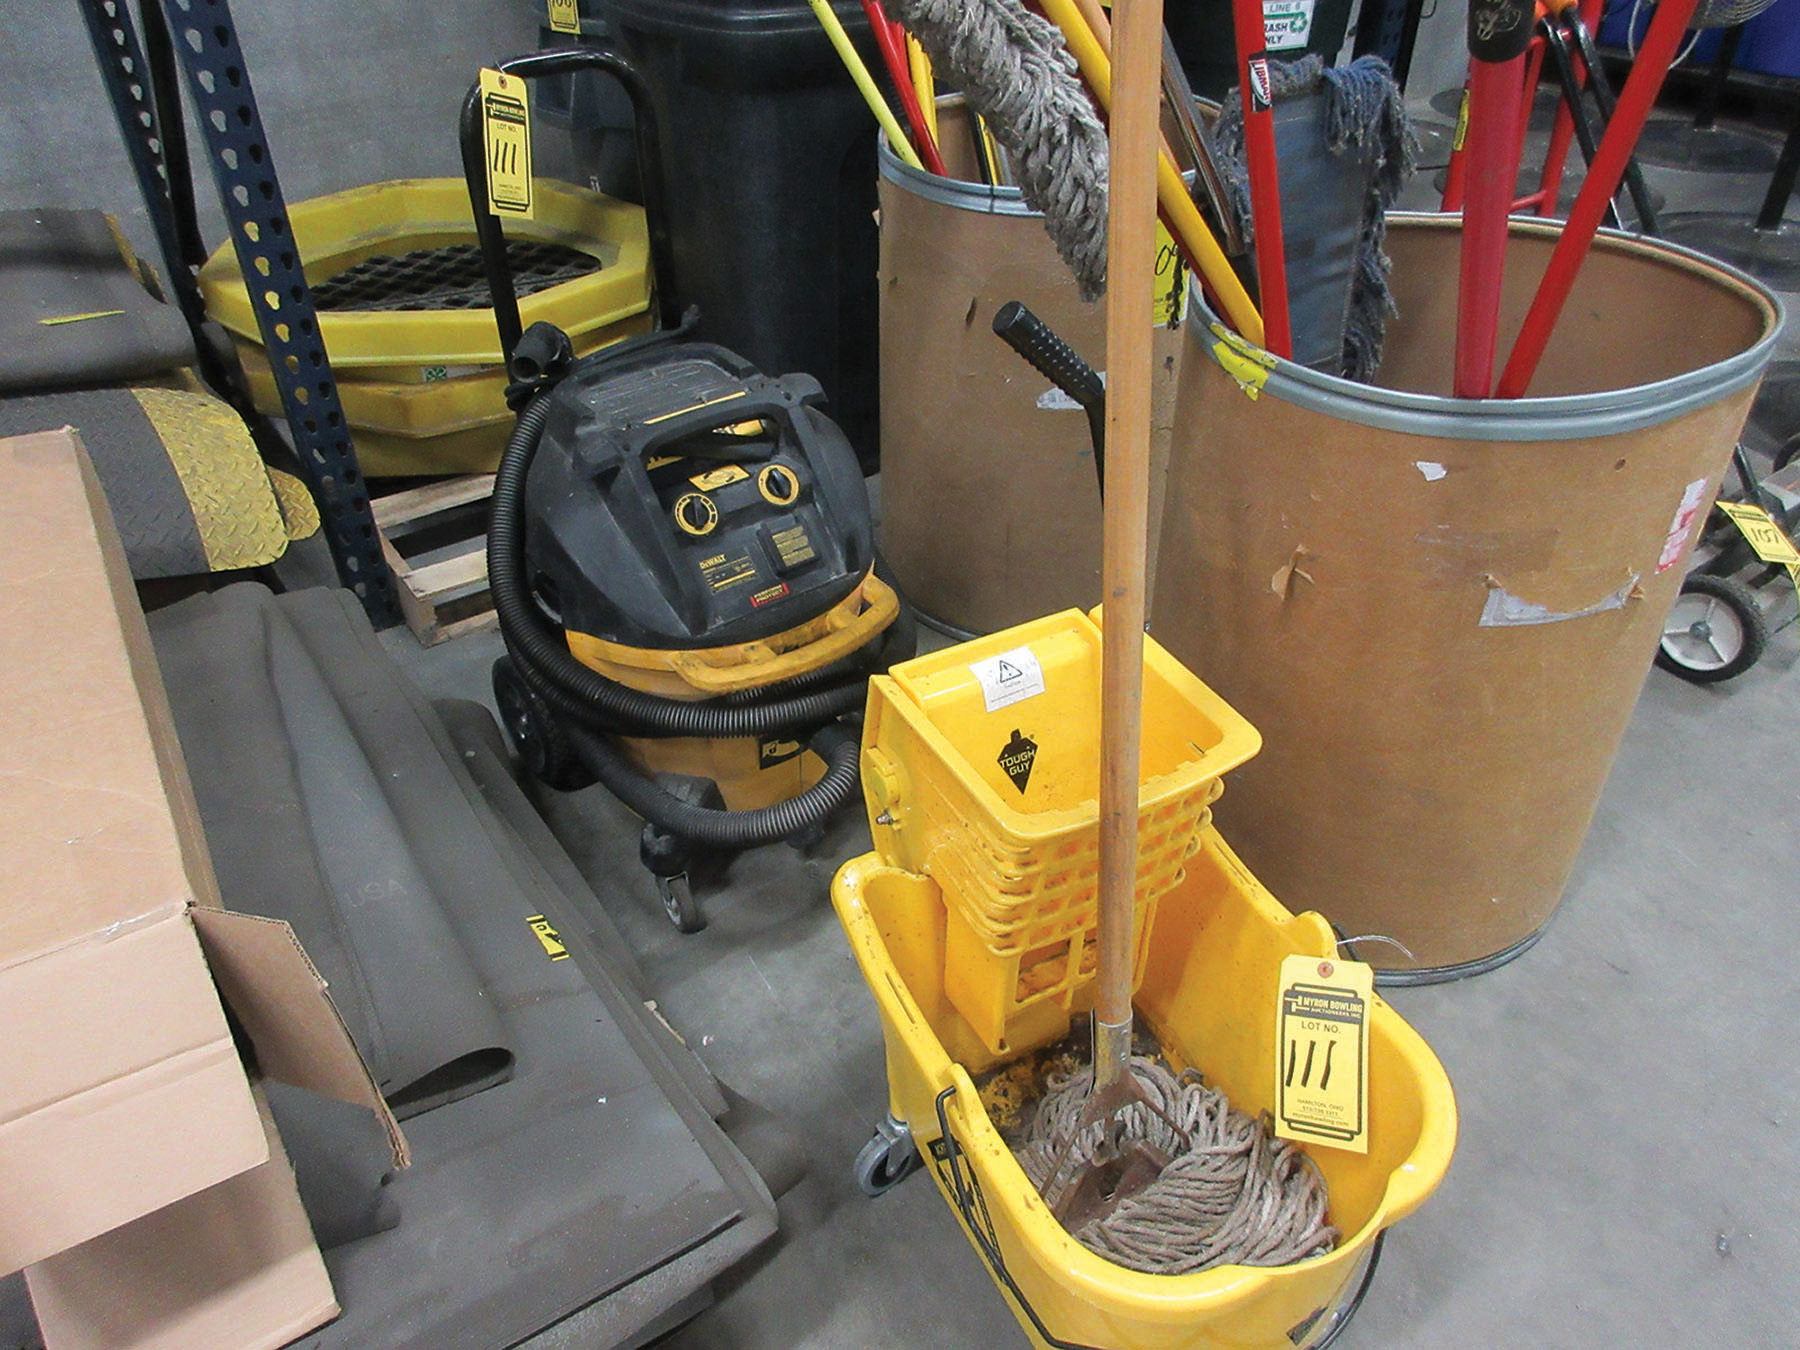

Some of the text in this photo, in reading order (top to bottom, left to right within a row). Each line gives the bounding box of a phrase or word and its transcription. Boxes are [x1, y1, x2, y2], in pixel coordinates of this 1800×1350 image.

[1269, 3, 1291, 13] LINE
[999, 749, 1036, 769] TOUGH
[1009, 761, 1031, 777] GUY
[1329, 1000, 1363, 1013] BOWLING
[1301, 1020, 1342, 1034] LOT NO.
